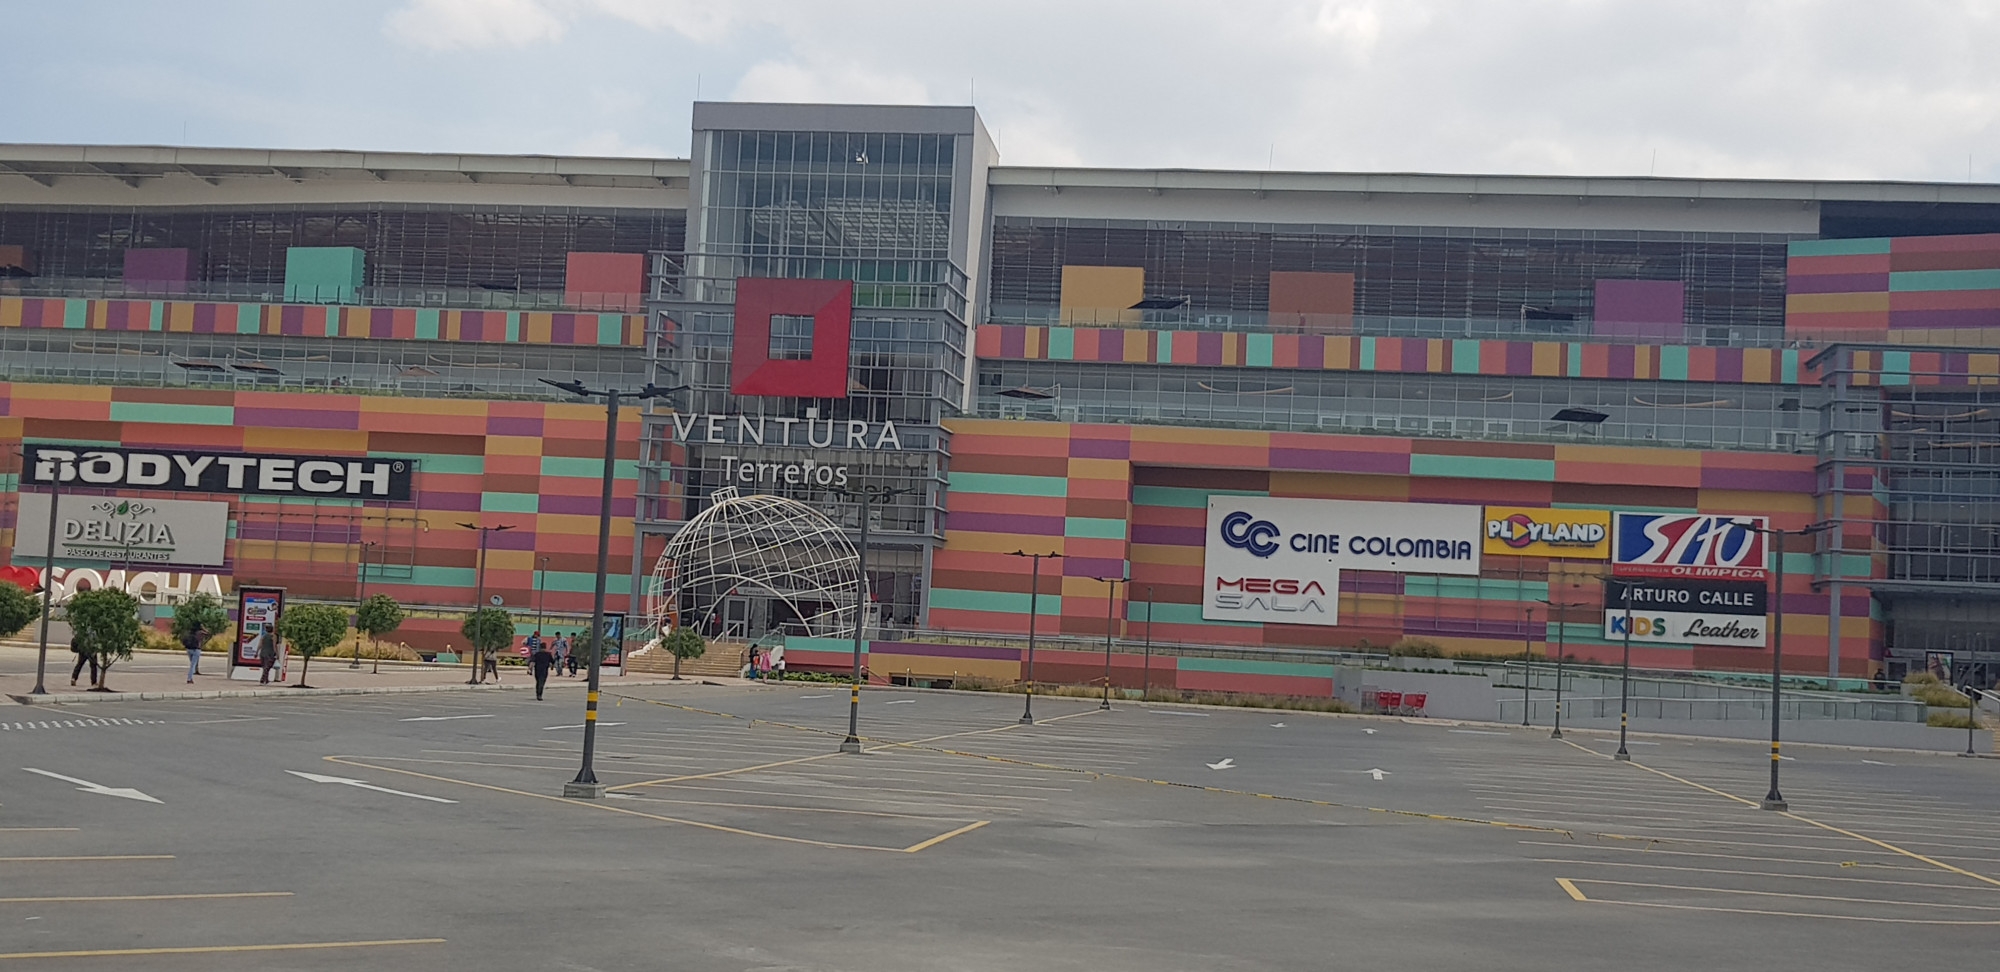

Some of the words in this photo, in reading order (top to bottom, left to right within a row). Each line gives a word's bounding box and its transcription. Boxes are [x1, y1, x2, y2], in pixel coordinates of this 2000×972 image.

[672, 407, 901, 450] VENTURA
[34, 449, 390, 495] BODYTECH
[720, 455, 848, 486] Terreros
[63, 519, 175, 545] DELIZIA
[66, 548, 91, 557] PASEO
[93, 549, 104, 559] DE
[1290, 533, 1340, 554] CINE
[1348, 535, 1472, 560] COLOMBIA
[38, 566, 223, 605] SOACHA
[1217, 576, 1325, 595] MEGA
[1620, 588, 1690, 604] ARTURO
[1699, 591, 1754, 606] CALLE
[1215, 593, 1324, 613] SALA
[1610, 616, 1667, 637] KIDS
[1682, 618, 1760, 640] Leather
